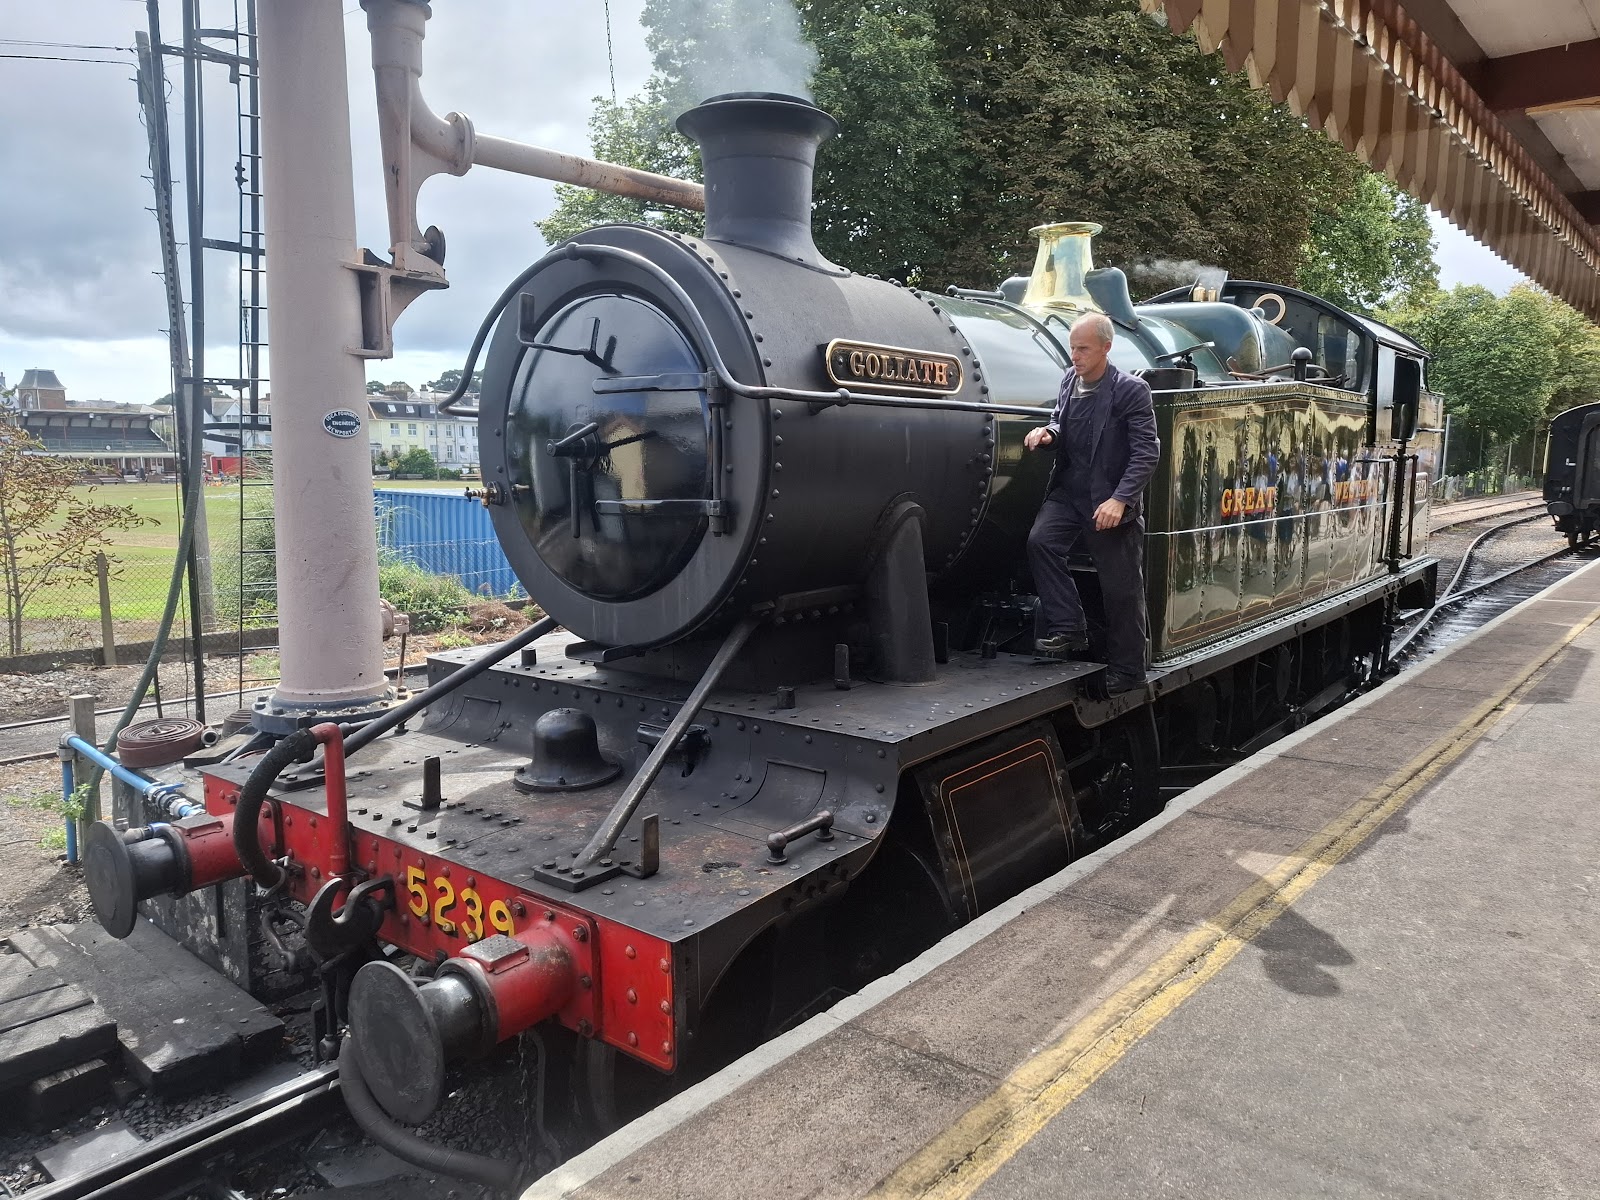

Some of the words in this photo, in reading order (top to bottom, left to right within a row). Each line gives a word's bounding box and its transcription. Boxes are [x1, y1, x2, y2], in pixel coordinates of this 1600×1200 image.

[850, 351, 948, 385] GOLIATH
[1221, 486, 1276, 516] GREAT
[407, 865, 515, 941] 5239
